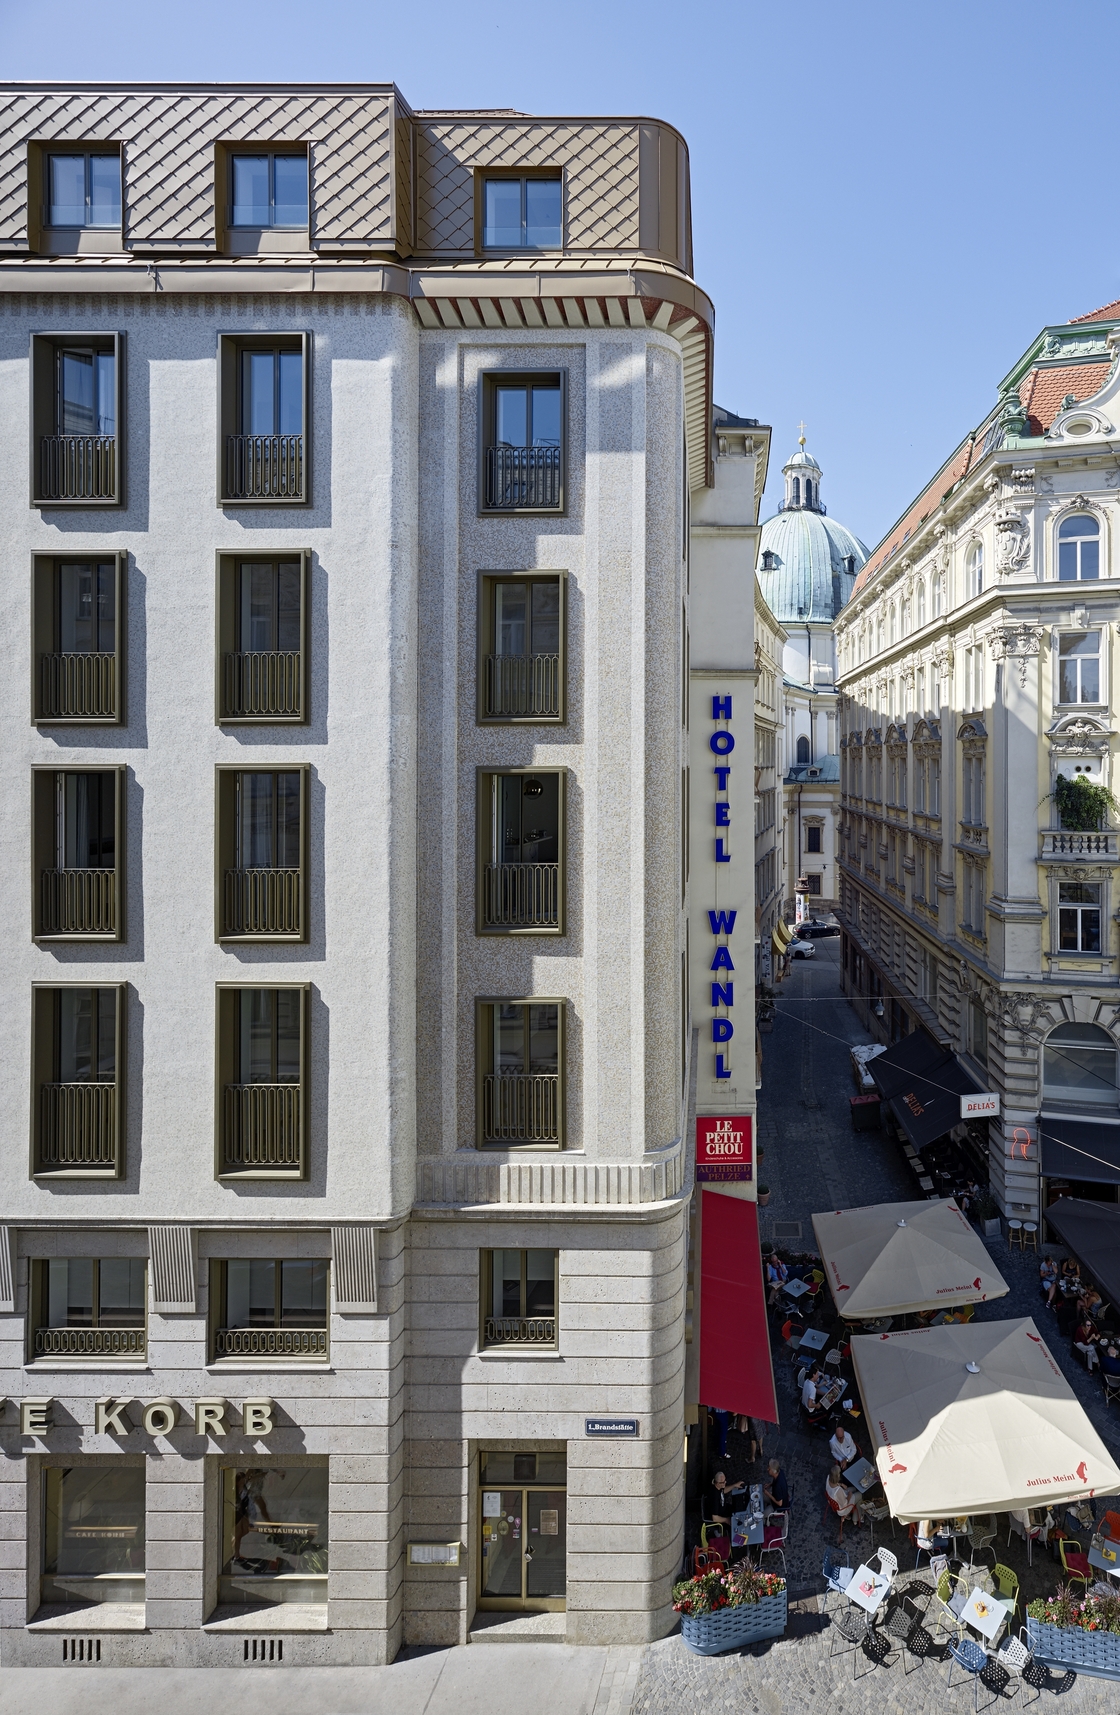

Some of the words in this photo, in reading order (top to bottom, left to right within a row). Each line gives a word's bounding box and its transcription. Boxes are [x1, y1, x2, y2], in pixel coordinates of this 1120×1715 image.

[709, 695, 735, 863] HOTEL
[707, 909, 738, 1079] WANDL
[967, 1101, 996, 1111] DELIA'S
[715, 1120, 733, 1132] LE
[705, 1131, 744, 1144] PETIT
[705, 1143, 744, 1155] CHOU
[698, 1164, 751, 1173] AUTHRIED
[708, 1172, 741, 1181] PELZE
[95, 1396, 278, 1436] KORB
[878, 1420, 889, 1442] Julius
[885, 1442, 896, 1463] Meinl
[1026, 1477, 1052, 1487] Julius
[1052, 1473, 1076, 1483] Meinl
[258, 1527, 309, 1535] RESTAURANT
